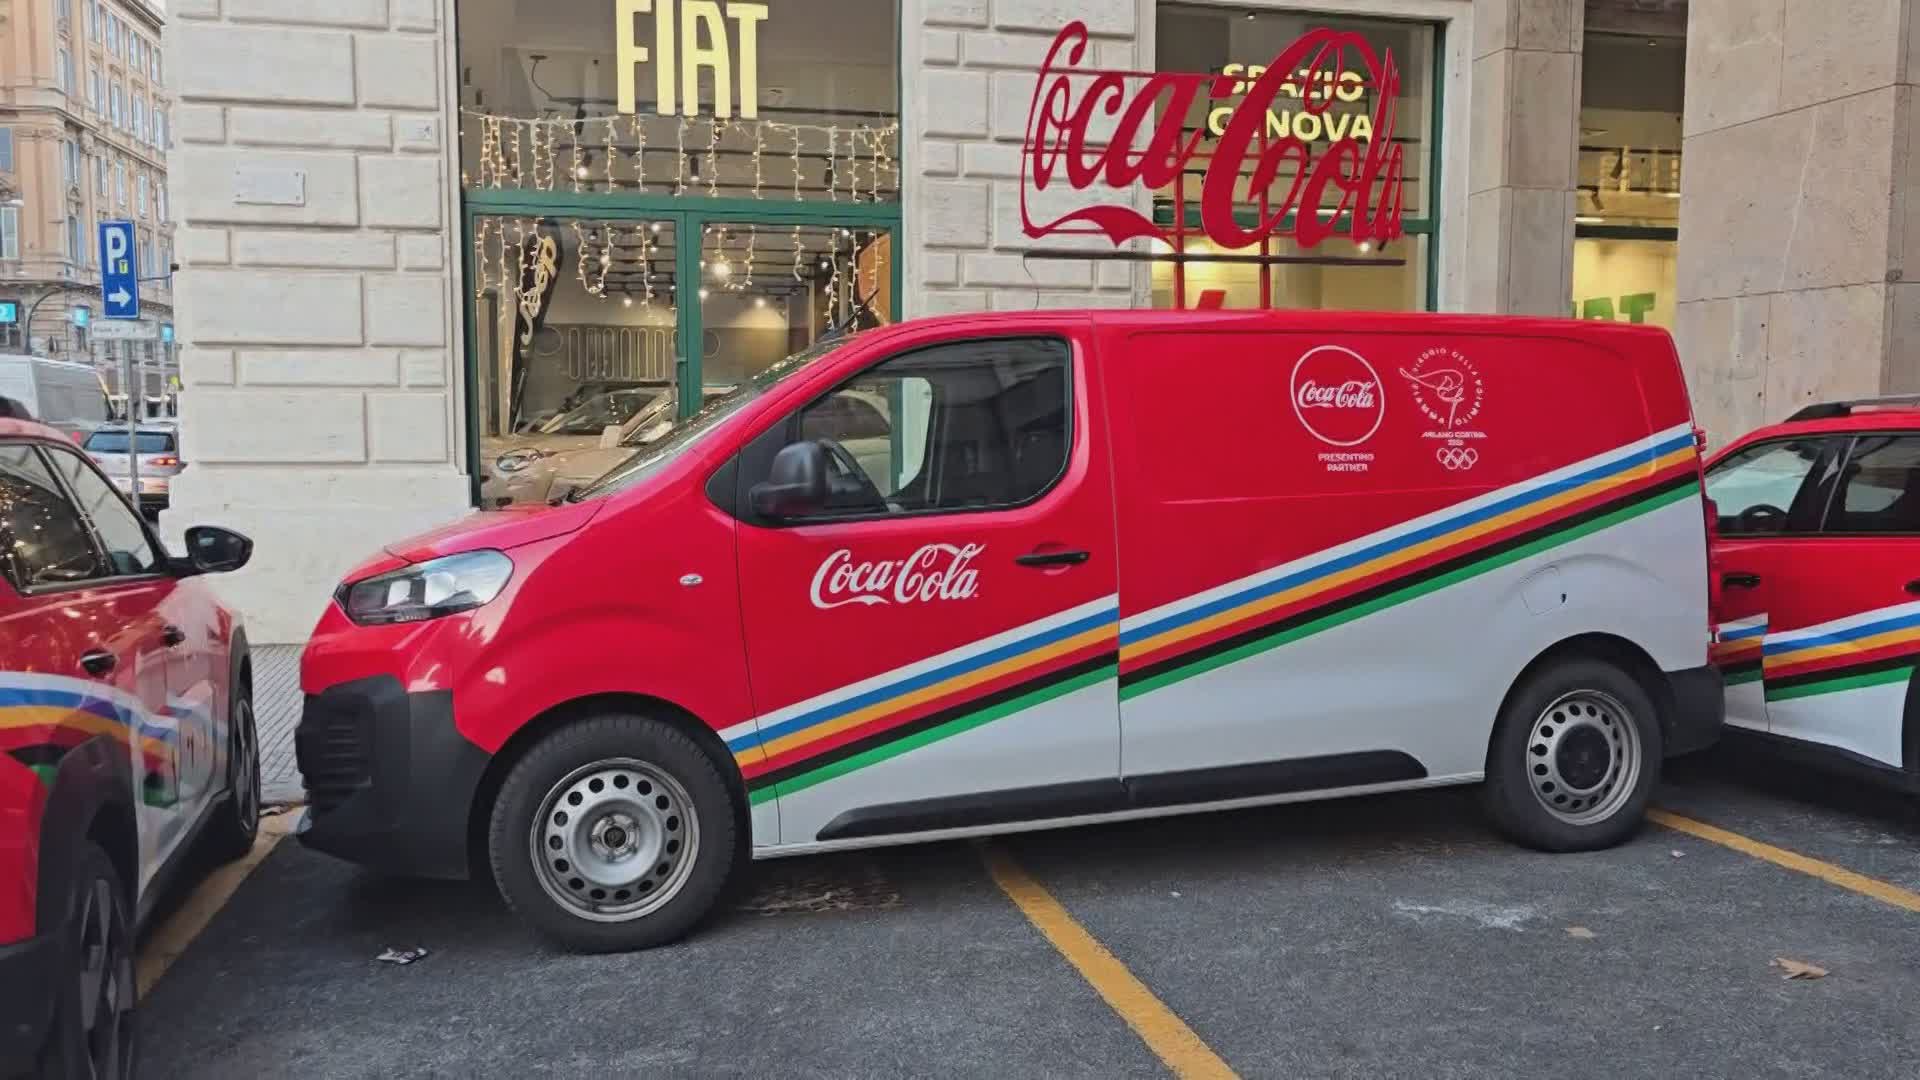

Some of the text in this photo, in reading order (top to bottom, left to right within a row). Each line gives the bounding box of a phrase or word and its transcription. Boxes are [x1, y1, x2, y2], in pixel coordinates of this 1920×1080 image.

[615, 0, 769, 120] FIAT
[1207, 106, 1374, 143] GNOVA
[105, 226, 127, 275] P
[1298, 379, 1378, 409] Coca-Cola
[809, 543, 986, 609] Coca-Cola
